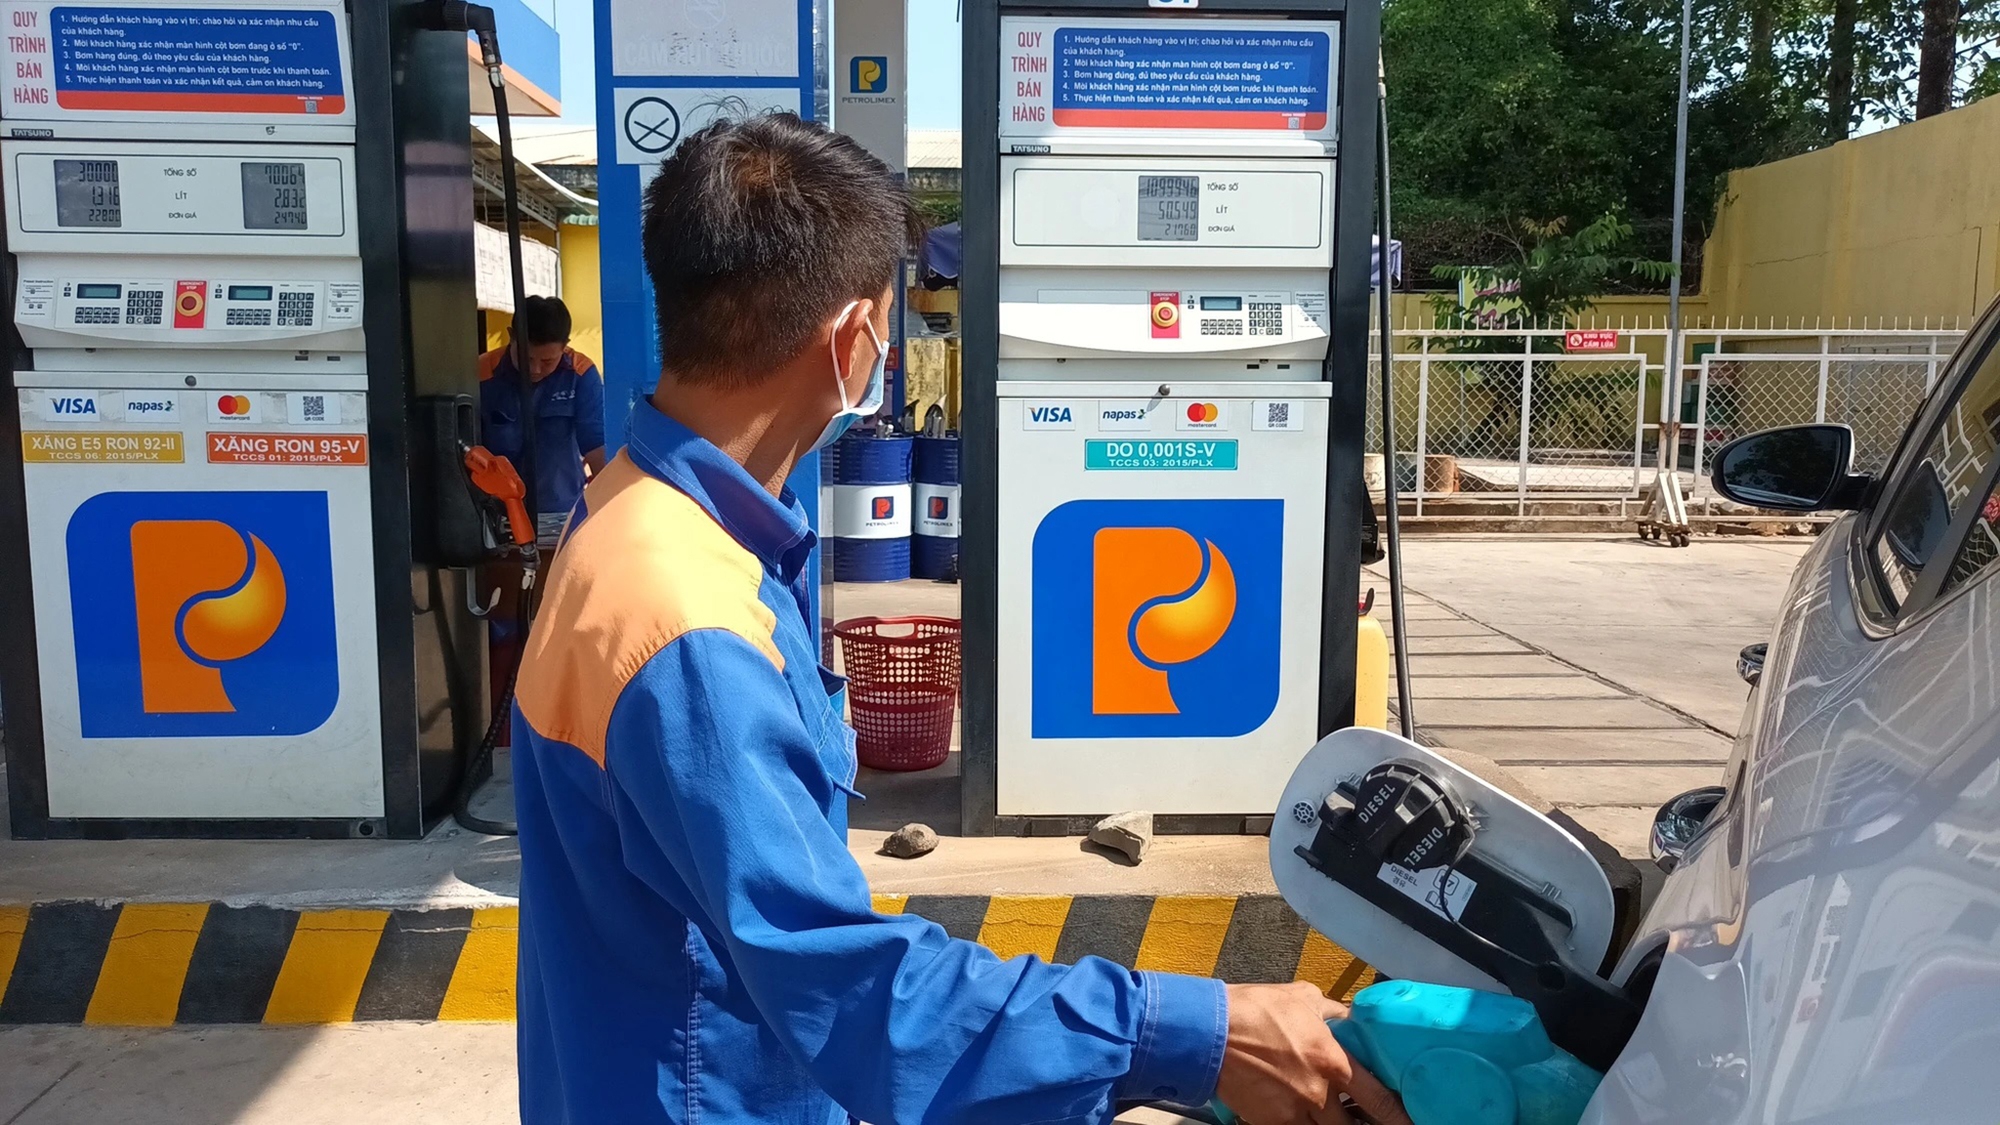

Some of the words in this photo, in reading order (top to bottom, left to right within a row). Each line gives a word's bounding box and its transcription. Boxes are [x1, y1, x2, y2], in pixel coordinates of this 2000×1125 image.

[13, 11, 38, 28] QUY
[8, 33, 46, 53] TRÌNH
[1017, 31, 1042, 48] QUY
[1118, 36, 1141, 44] khách
[16, 58, 43, 79] BÁN
[1011, 53, 1047, 73] TRÌNH
[1115, 60, 1134, 69] hàng
[1093, 72, 1113, 81] hàng
[1150, 72, 1167, 80] theo
[13, 84, 49, 104] HÀNG
[1017, 77, 1041, 97] BÁN
[1115, 84, 1134, 92] hàng
[1276, 85, 1298, 93] thanh
[1167, 95, 1180, 103] xác
[1264, 96, 1287, 104] khách
[1012, 102, 1045, 122] HÀNG
[13, 129, 52, 137] TATSUNO
[1012, 145, 1049, 153] TATSUNO
[79, 162, 118, 182] 30000
[175, 190, 187, 200] LÍT
[89, 209, 120, 222] 22800
[1215, 204, 1228, 214] LÍT
[274, 211, 307, 224] 24740
[1164, 223, 1196, 236] 21760
[49, 397, 96, 414] VISA
[128, 401, 164, 413] napas
[1027, 407, 1072, 422] VISA
[1102, 410, 1136, 422] napas
[32, 434, 77, 450] XĂNG
[81, 437, 102, 450] E5
[106, 438, 139, 450] RON
[143, 437, 175, 450] 92-II
[214, 435, 269, 452] XĂNG
[274, 439, 314, 453] RON
[320, 440, 360, 454] 95-V
[49, 452, 82, 460] TCCS
[84, 452, 102, 460] 06:
[106, 452, 159, 460] 2015/PLX
[233, 453, 265, 461] TCCS
[268, 454, 286, 462] 01:
[289, 454, 343, 462] 2015/PLX
[1106, 443, 1133, 457] DO
[1138, 443, 1216, 459] 0,001S-V
[1109, 459, 1140, 467] TCCS
[1143, 459, 1159, 467] 03:
[1162, 459, 1213, 467] 2015/PLX
[1358, 783, 1396, 824] DIESEL
[1403, 826, 1444, 866] DIESEL
[1390, 865, 1418, 887] DIESEL
